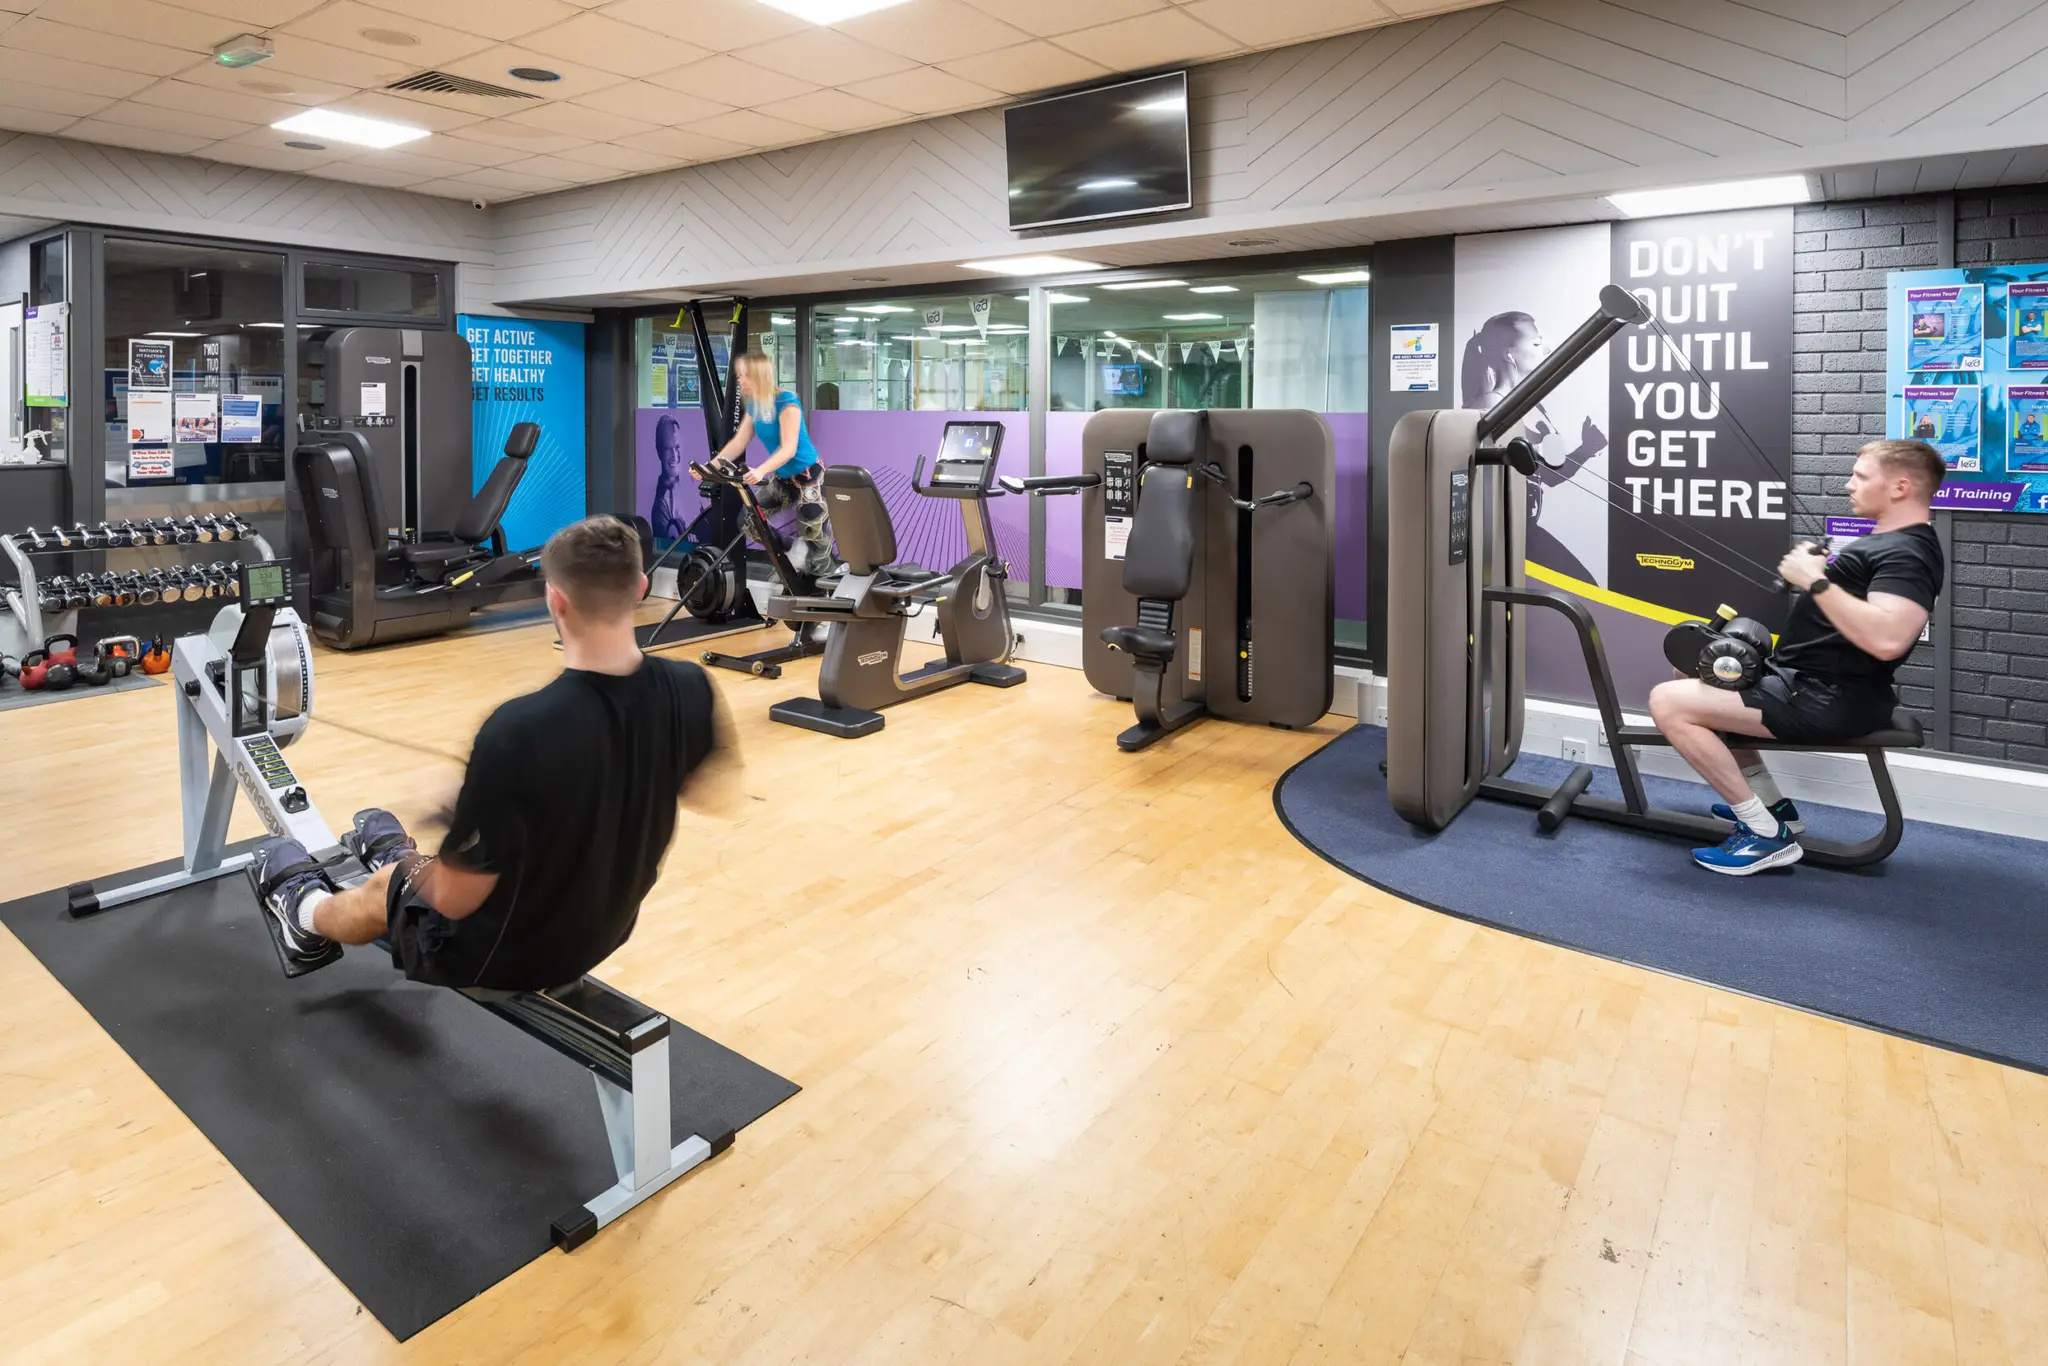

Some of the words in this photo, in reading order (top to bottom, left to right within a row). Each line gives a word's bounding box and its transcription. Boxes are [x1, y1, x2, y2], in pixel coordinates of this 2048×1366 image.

[1630, 230, 1774, 278] DON'T
[973, 298, 988, 313] led
[926, 310, 940, 324] led
[467, 328, 490, 344] GET
[493, 329, 535, 346] ACTIVE
[494, 349, 552, 365] TOGETHER
[1628, 332, 1769, 373] UNTIL
[494, 367, 545, 383] HEALTHY
[494, 387, 545, 402] RESULTS
[1624, 382, 1720, 420] YOU
[1627, 430, 1716, 468] GET
[1961, 460, 1976, 468] led
[1625, 477, 1787, 520] THERE
[1953, 488, 2012, 503] Training
